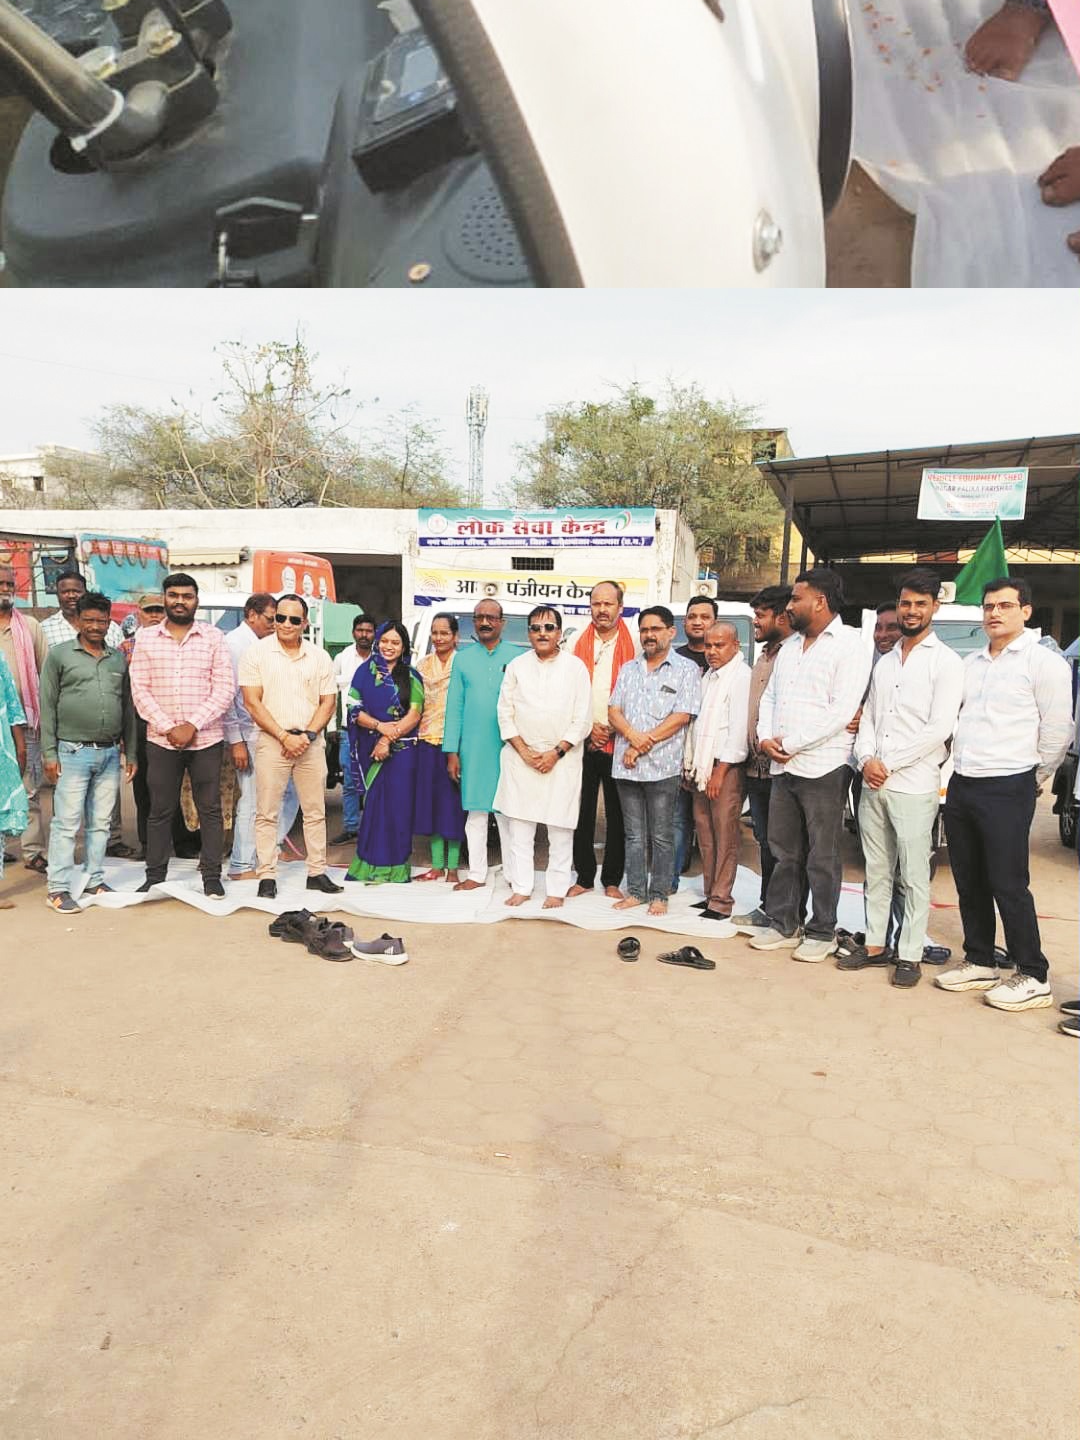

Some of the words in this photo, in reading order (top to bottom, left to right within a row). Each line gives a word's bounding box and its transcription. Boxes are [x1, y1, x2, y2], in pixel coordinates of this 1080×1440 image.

[457, 517, 505, 535] लोक
[512, 516, 555, 535] सेवा
[561, 516, 608, 535] केन्द्र
[506, 578, 562, 598] पंजीयन
